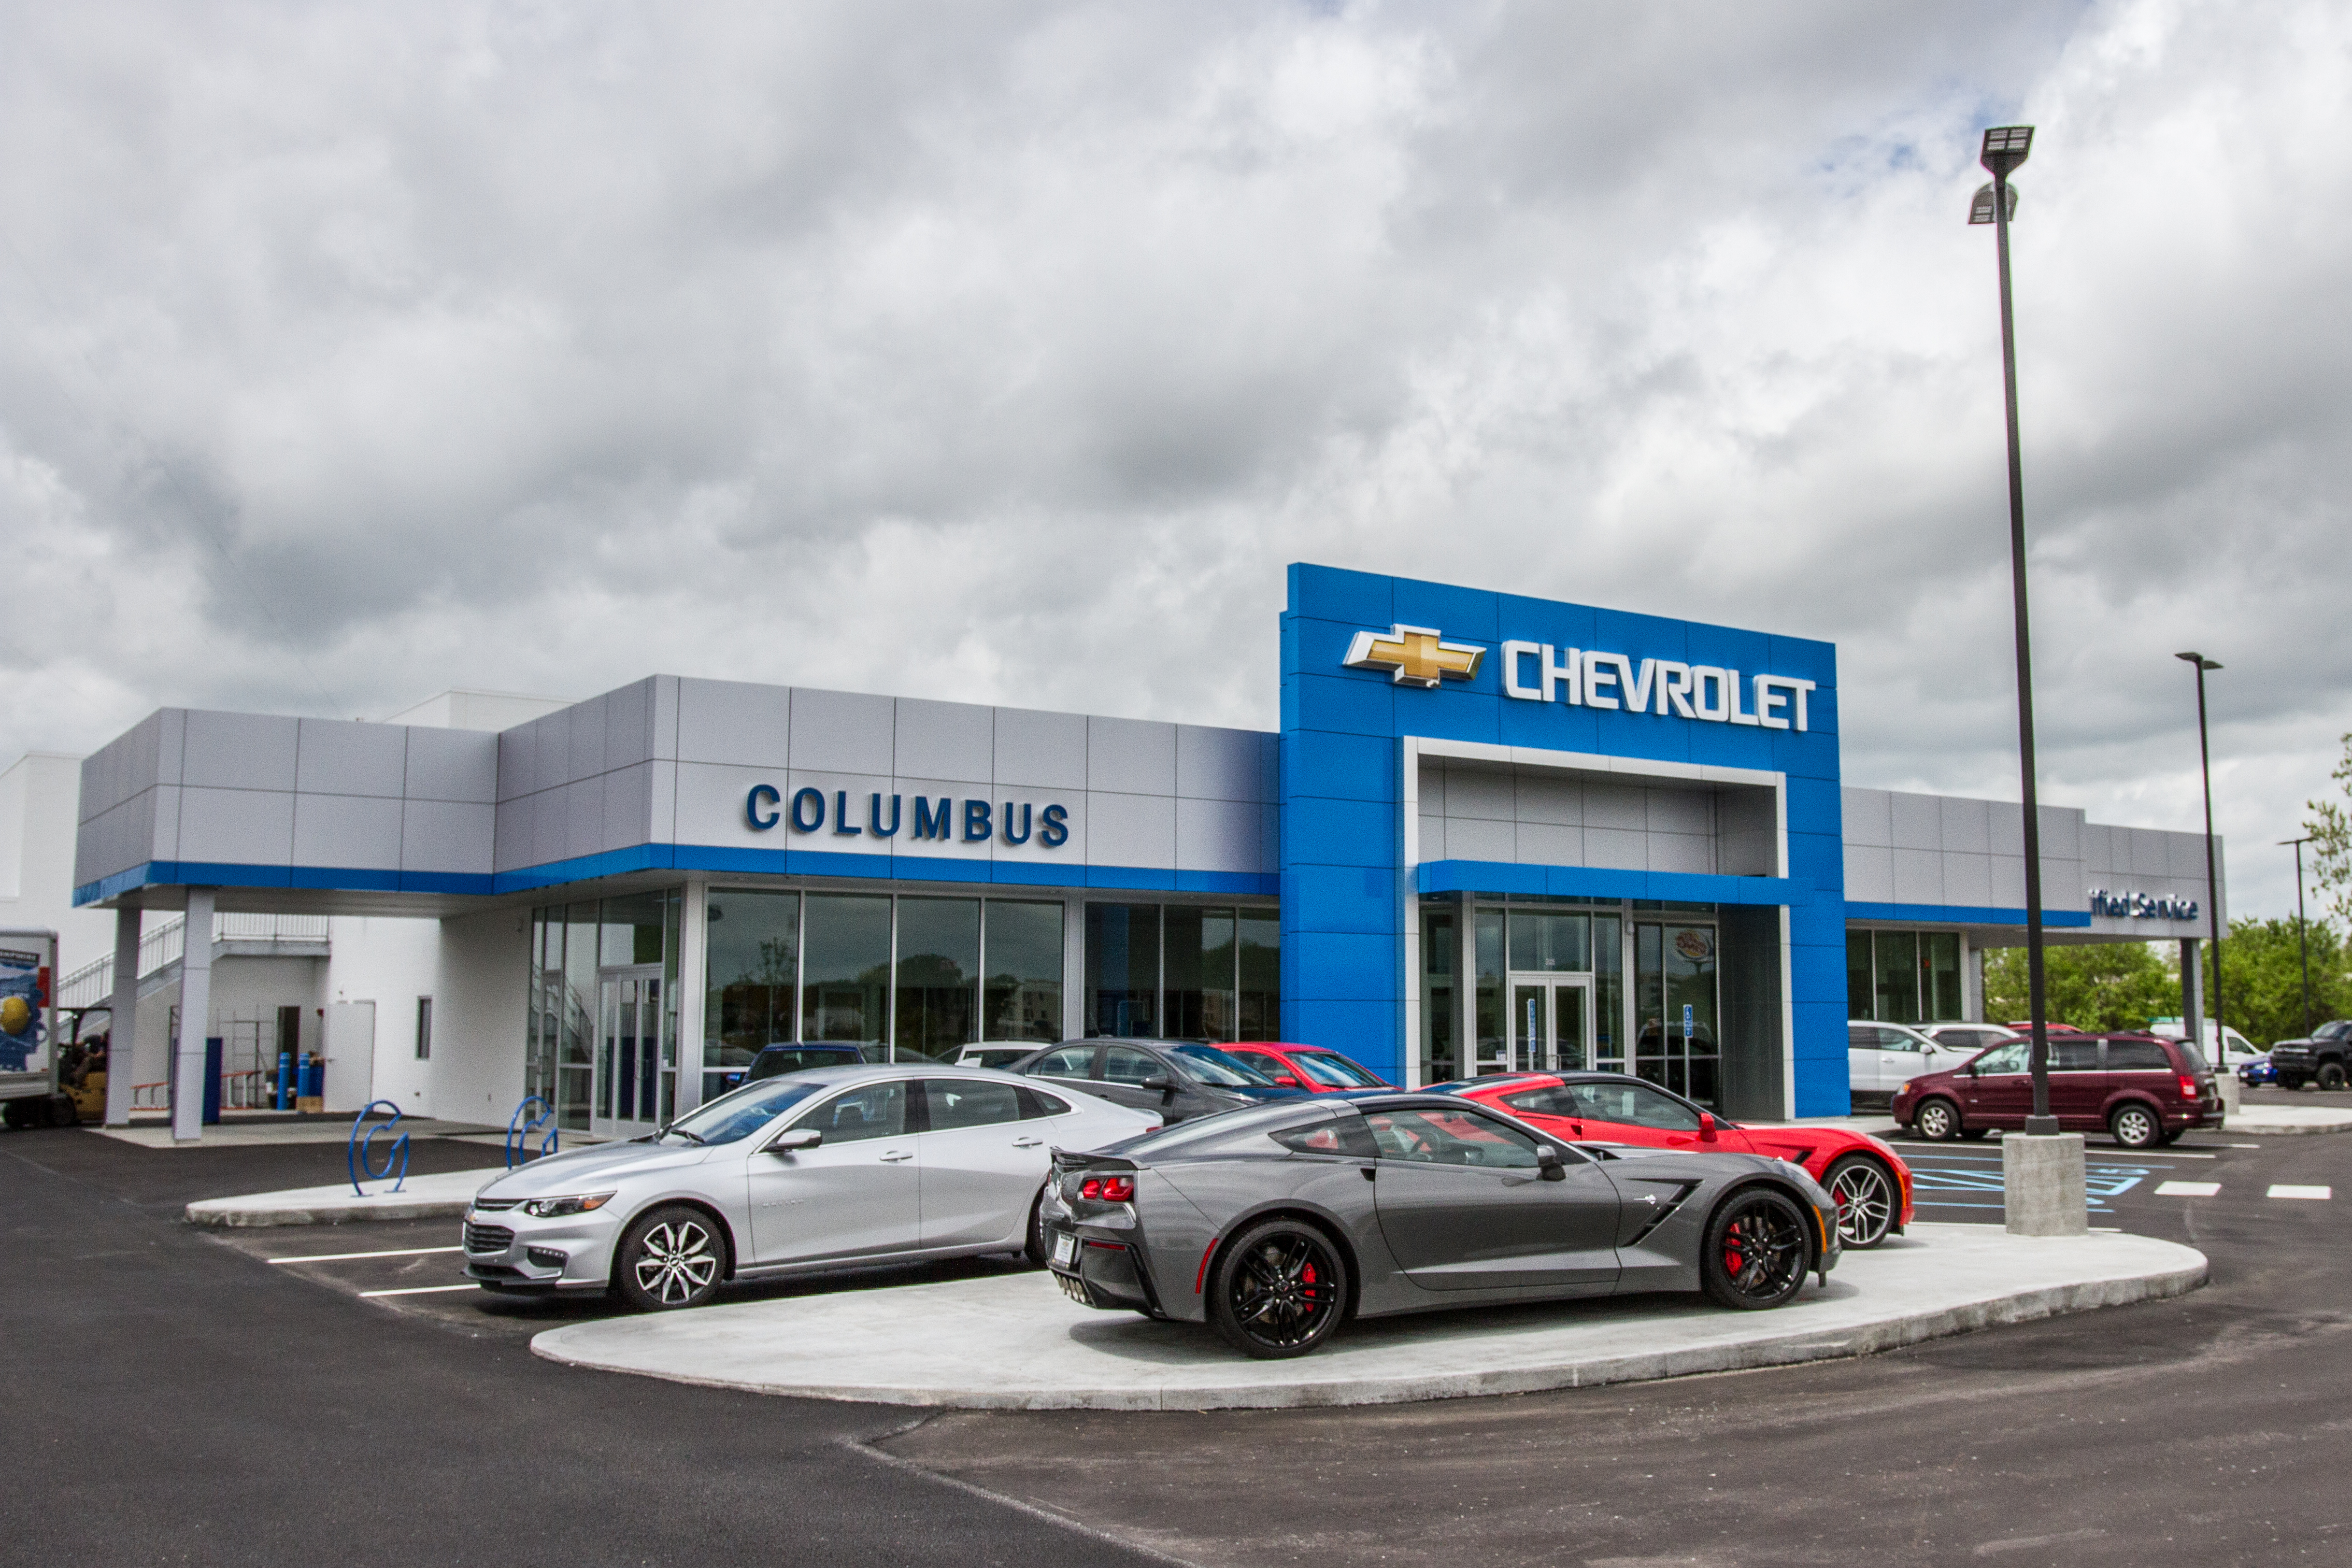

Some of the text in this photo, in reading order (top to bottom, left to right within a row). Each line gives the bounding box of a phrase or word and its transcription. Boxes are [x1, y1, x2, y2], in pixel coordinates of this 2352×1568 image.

[1501, 639, 1816, 731] CHEVROLET
[746, 783, 1069, 847] COLUMBUS
[2132, 892, 2199, 920] Service
